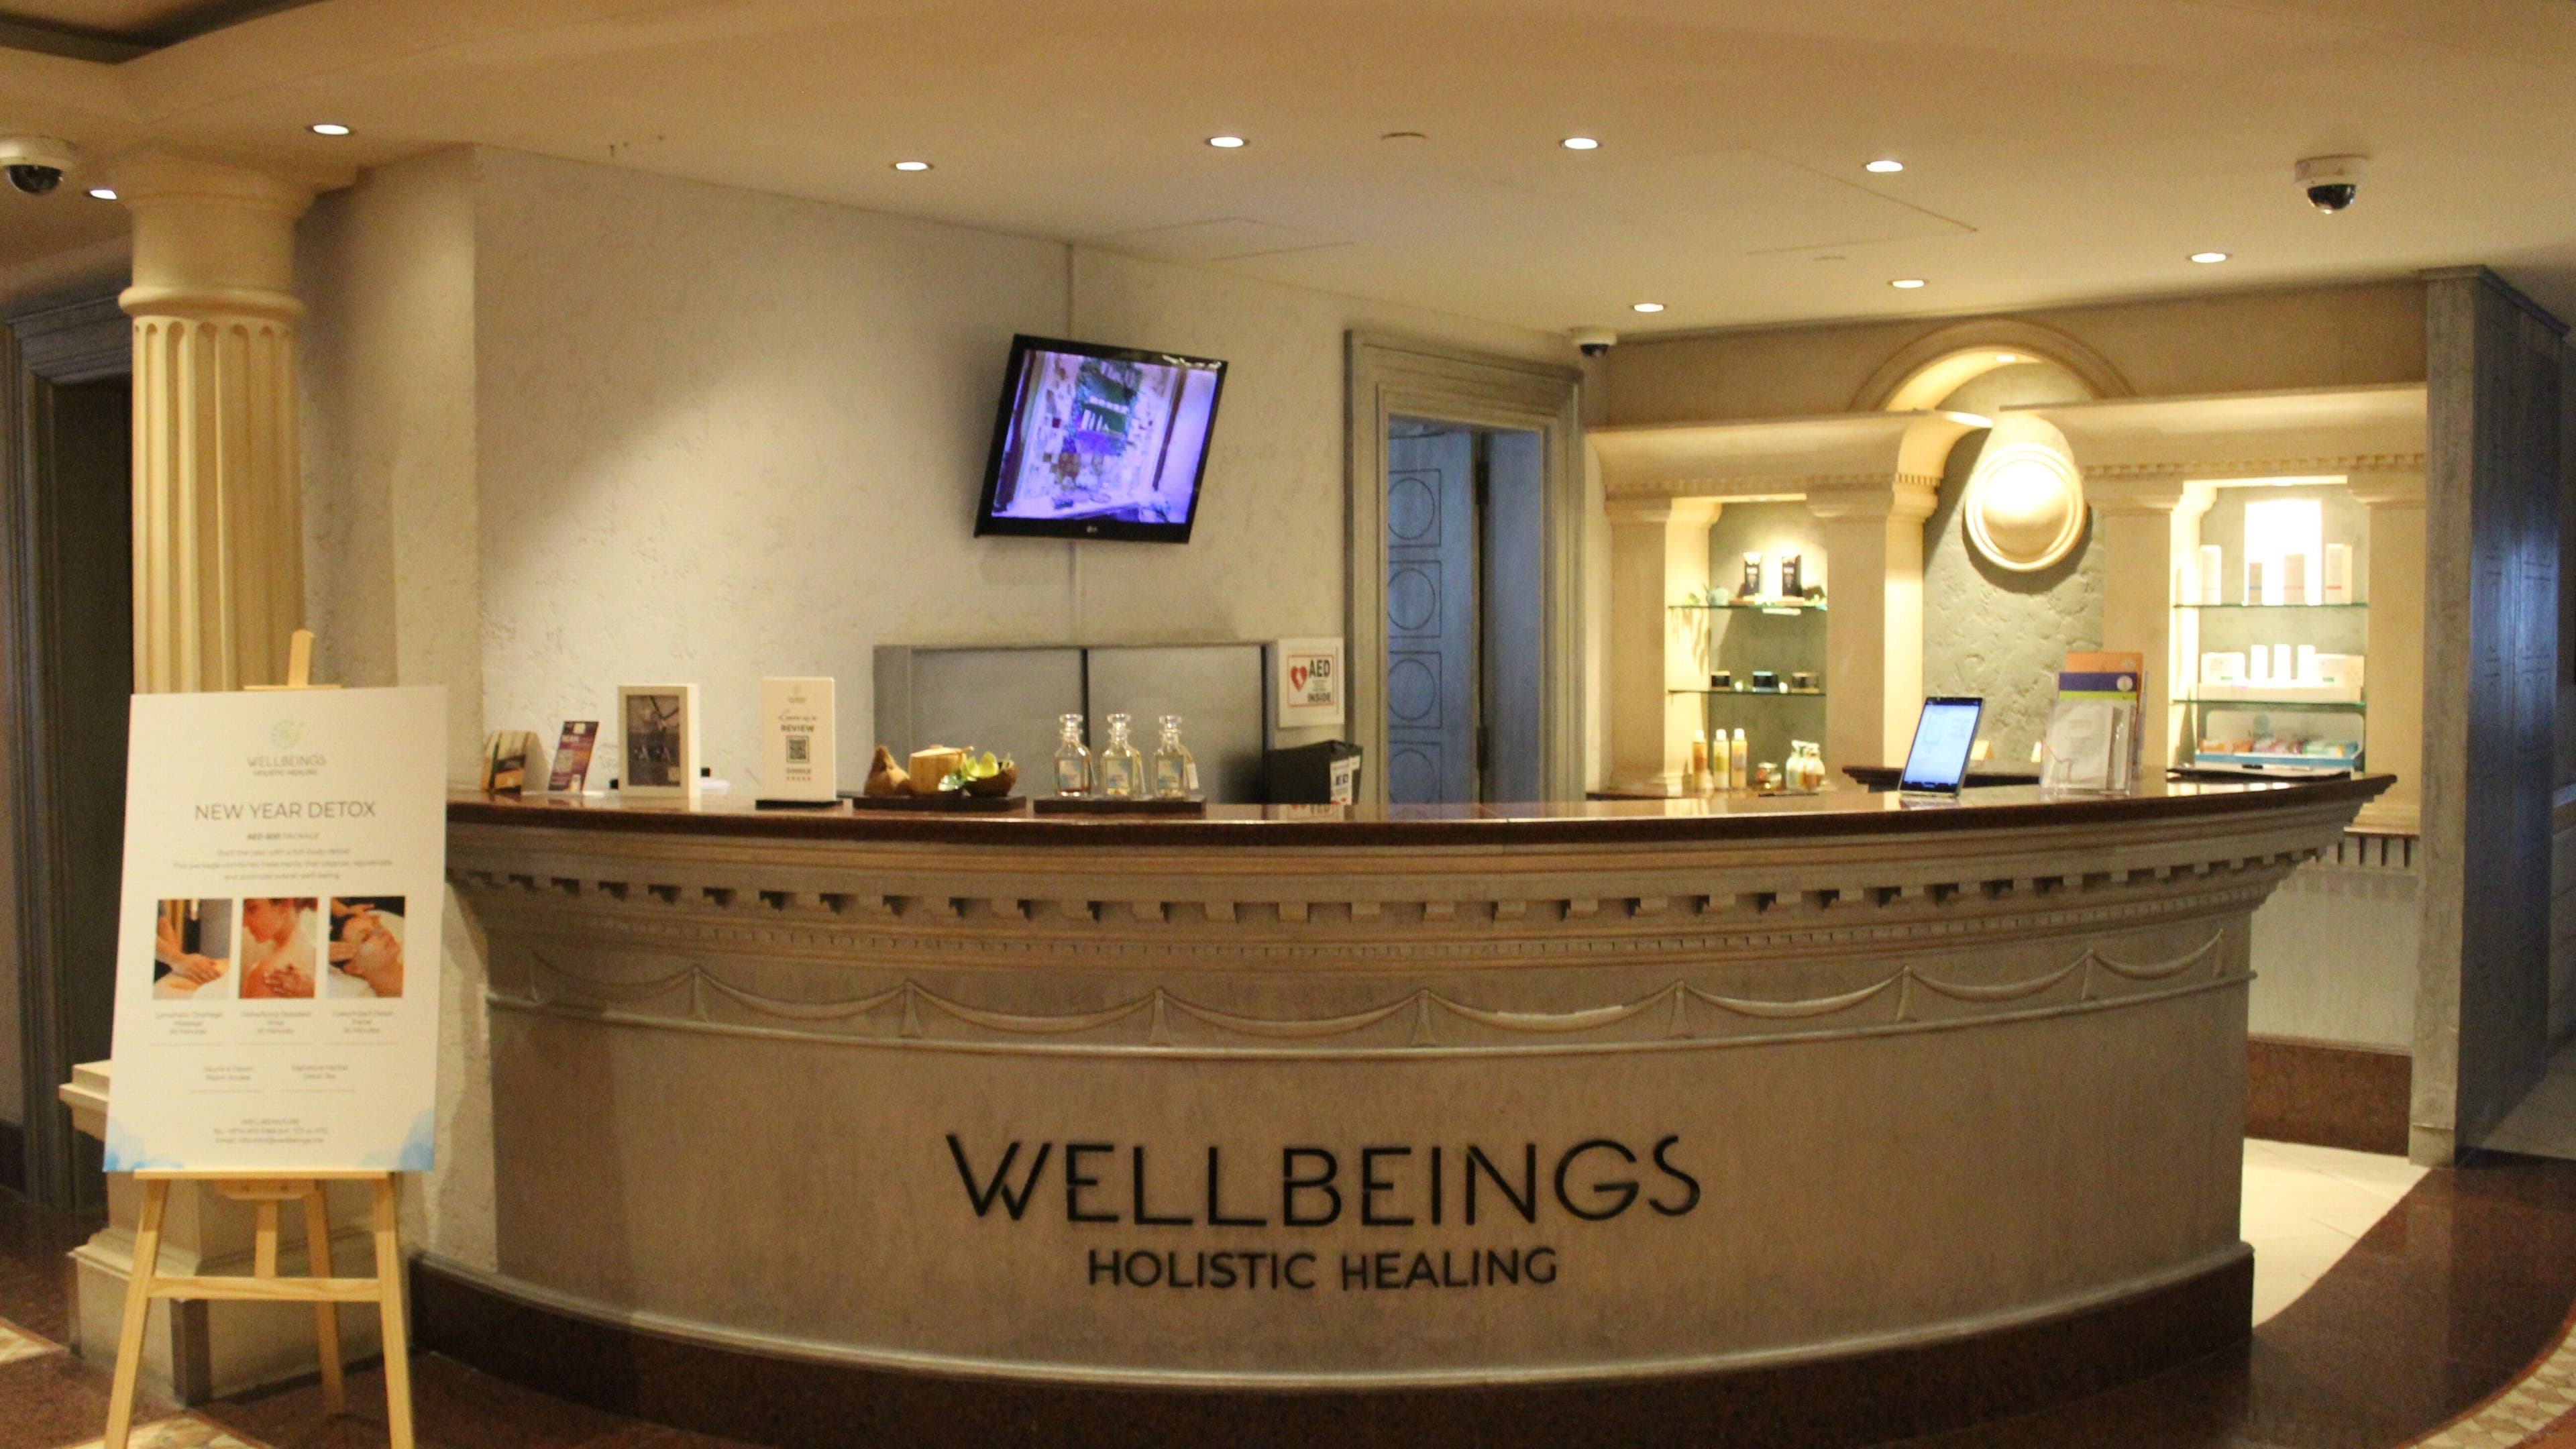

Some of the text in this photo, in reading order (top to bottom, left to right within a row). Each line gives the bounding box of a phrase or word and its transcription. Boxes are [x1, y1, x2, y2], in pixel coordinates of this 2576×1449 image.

[1309, 659, 1331, 678] AED
[1307, 692, 1332, 703] INSIDE
[246, 754, 327, 767] WELLBEINGS
[195, 800, 376, 820] NEW YEAR DETOX
[945, 1134, 1701, 1228] WELLBEINGS
[1089, 1247, 1557, 1291] HOLISTIC HEALING
